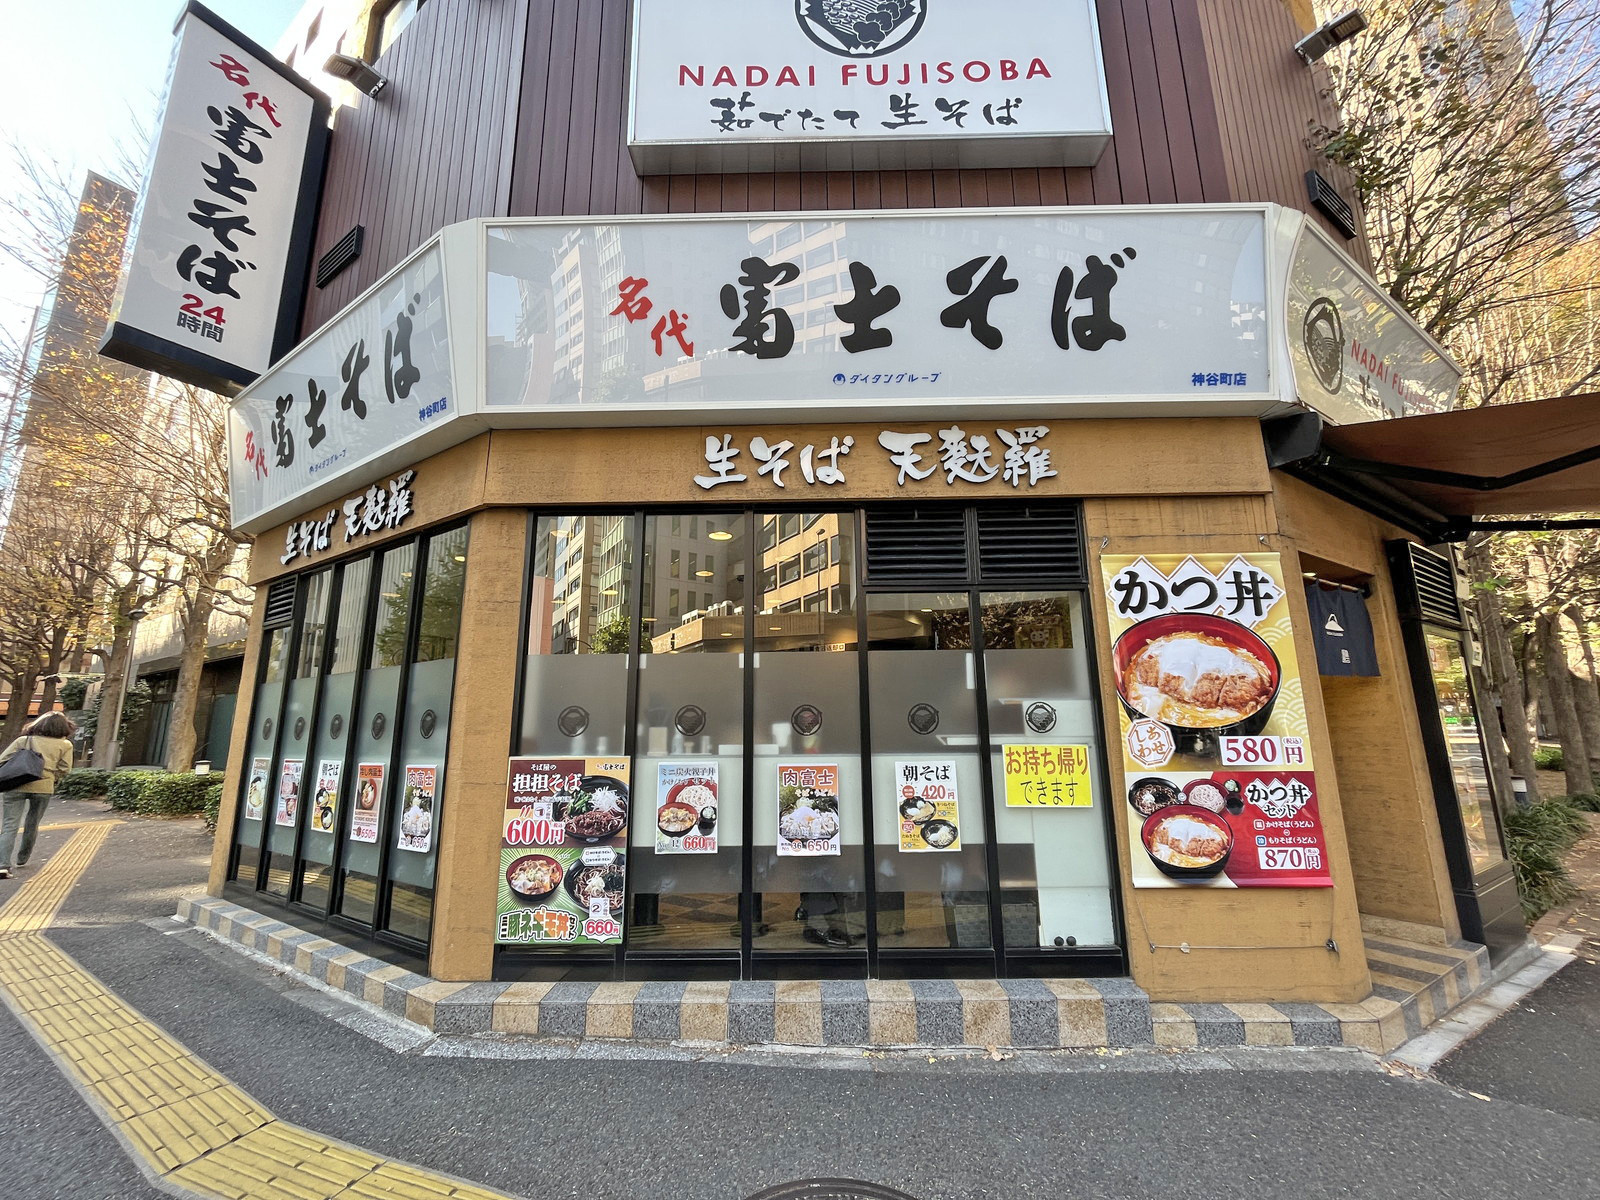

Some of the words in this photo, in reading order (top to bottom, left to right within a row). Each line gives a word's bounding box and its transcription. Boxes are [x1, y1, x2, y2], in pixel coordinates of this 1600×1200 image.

[678, 64, 816, 88] NADAI
[841, 57, 1052, 86] FUJISOBA
[209, 53, 282, 128] 名代
[881, 93, 1022, 129] 生そば
[179, 294, 226, 325] 24
[609, 276, 695, 357] 名代
[176, 313, 224, 343] 時間
[1351, 339, 1389, 383] NADAI
[850, 372, 942, 384] ダイタングループ
[1191, 372, 1247, 387] 神谷町店
[418, 397, 447, 422] 神谷町店
[245, 431, 268, 481] 名代
[693, 433, 855, 489] 生そば
[280, 508, 336, 566] 生そば
[1114, 570, 1273, 617] かつ丼
[903, 764, 951, 782] 朝そば
[1006, 747, 1088, 776] お持ち帰り
[408, 771, 434, 788] 肉富士
[513, 773, 582, 793] 担担そば
[783, 769, 833, 786] 肉富士
[1020, 777, 1078, 806] できます
[1248, 784, 1309, 804] かつ丼
[1264, 805, 1296, 818] セット
